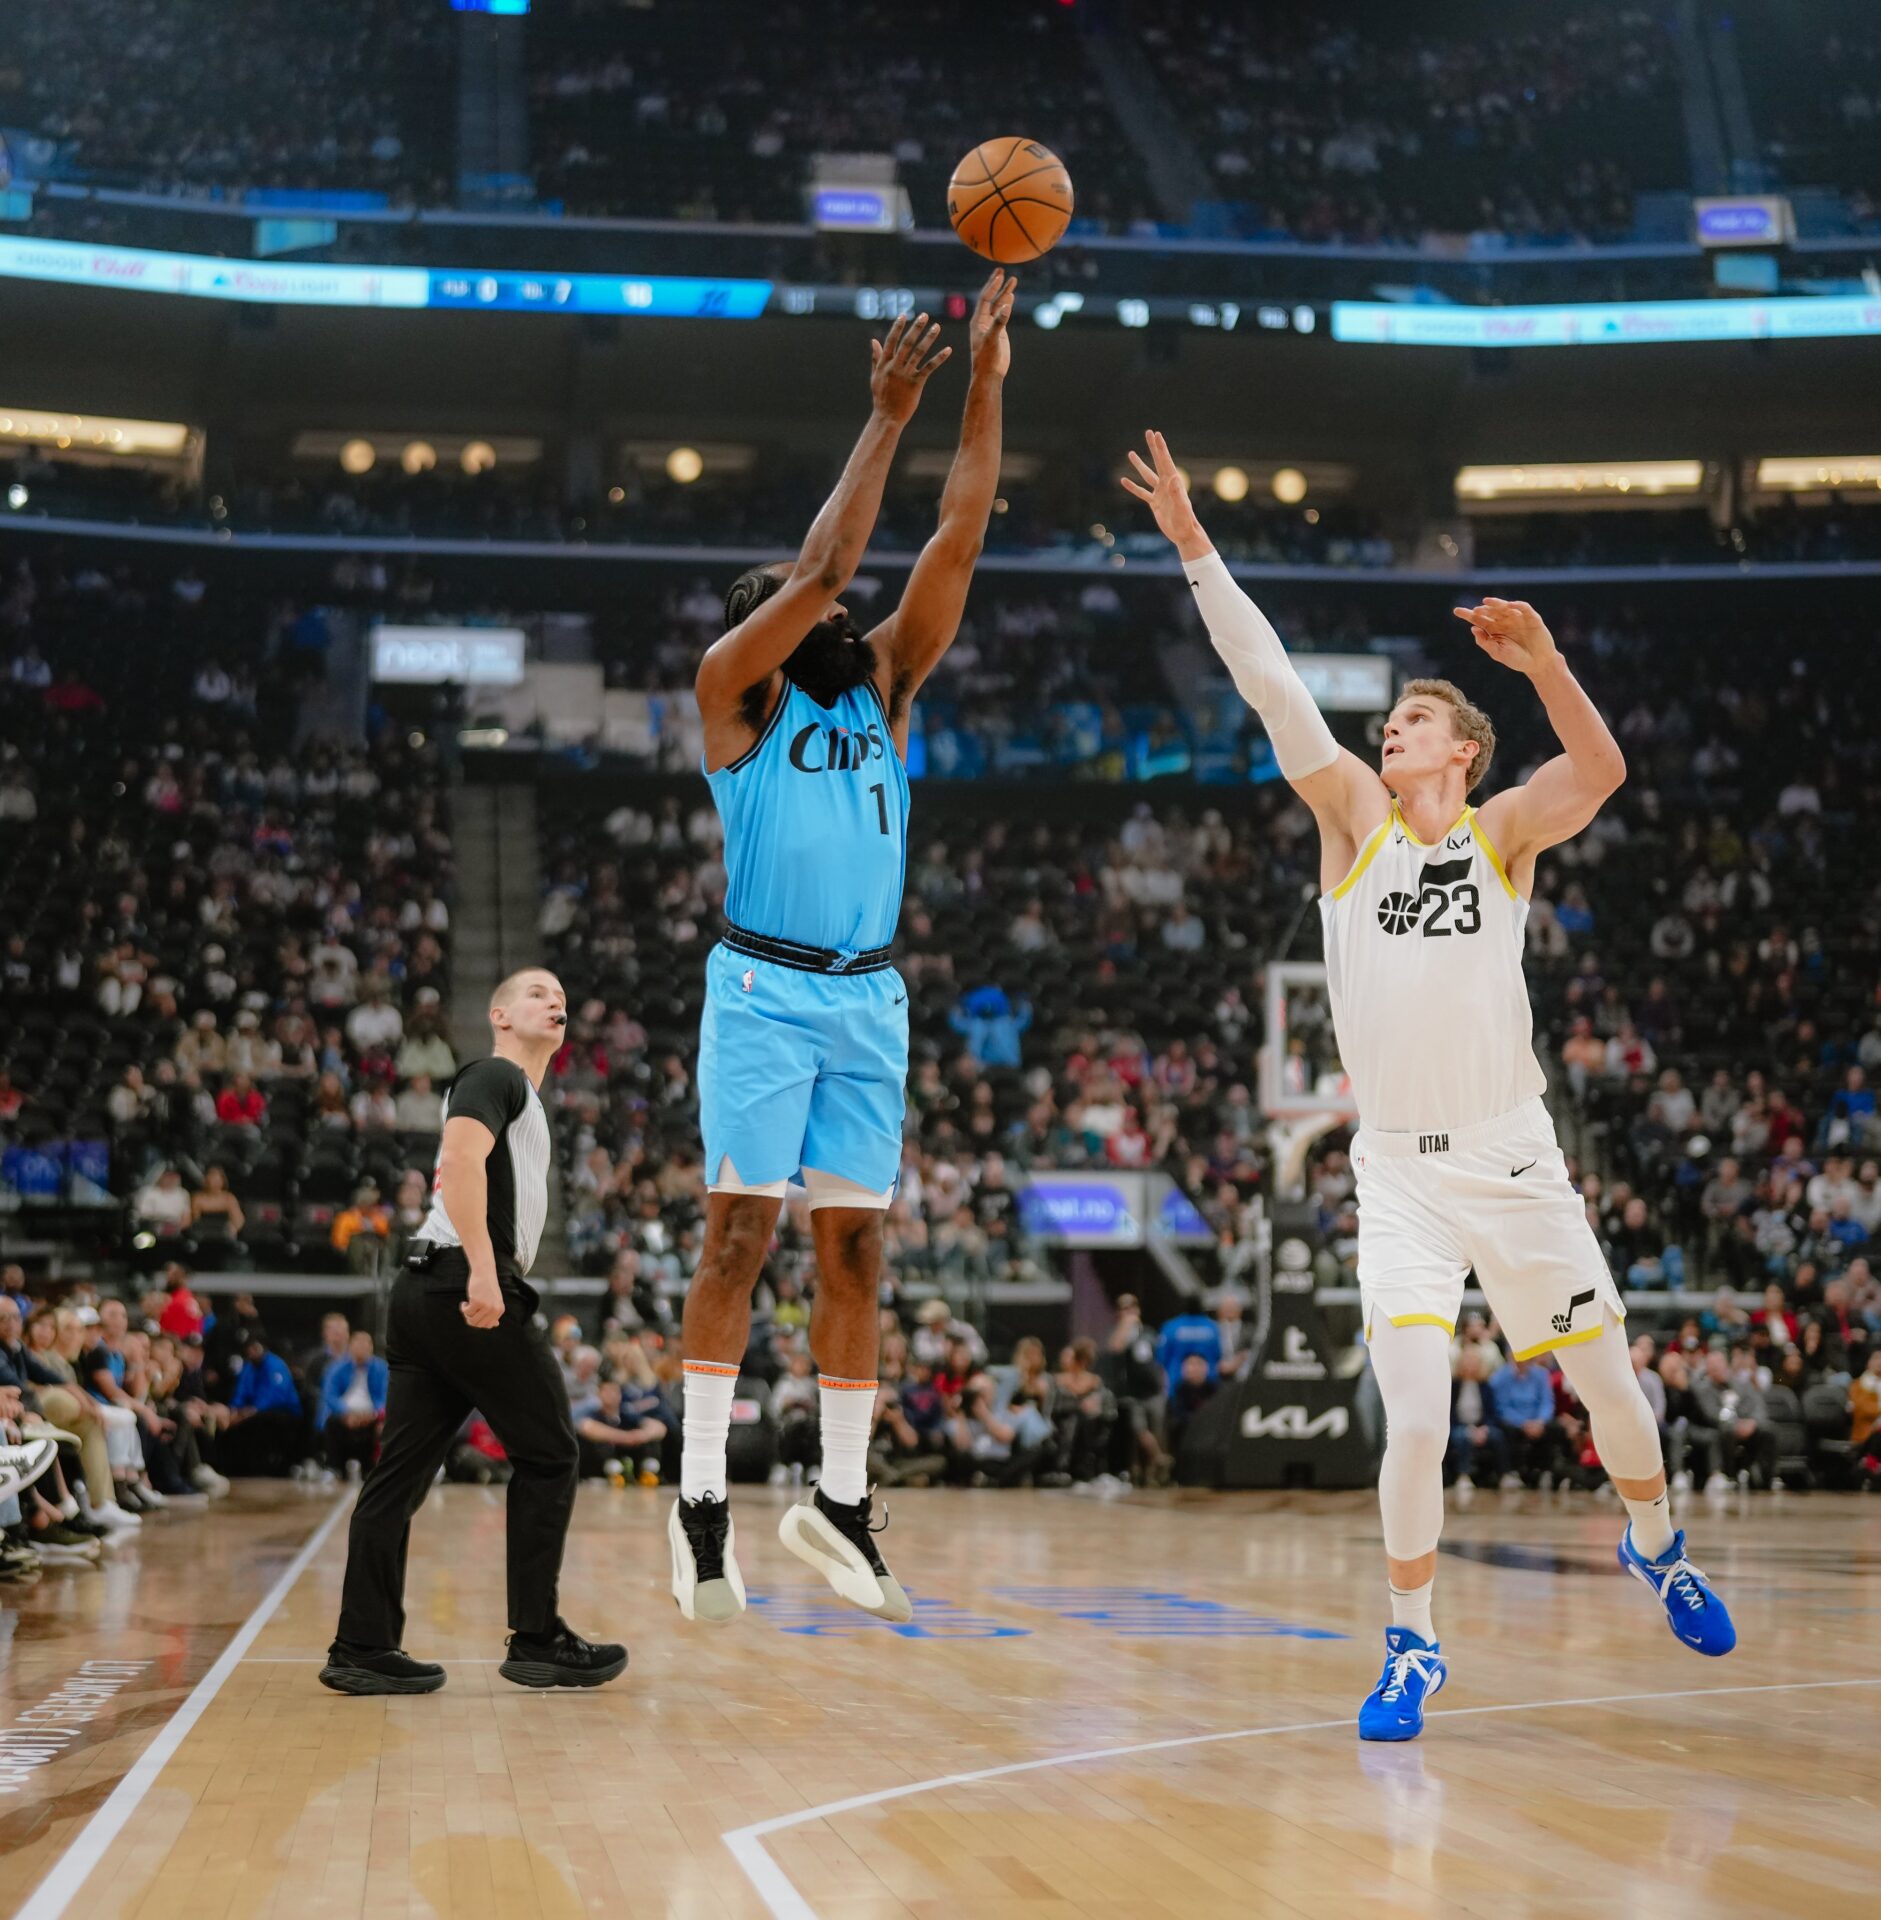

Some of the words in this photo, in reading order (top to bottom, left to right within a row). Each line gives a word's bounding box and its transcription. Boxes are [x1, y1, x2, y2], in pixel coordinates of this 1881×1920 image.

[789, 721, 884, 773] Clips
[869, 783, 890, 835] 1
[1422, 884, 1481, 937] 23
[1419, 1133, 1450, 1154] UTAH
[15, 1677, 135, 1723] ANGELES
